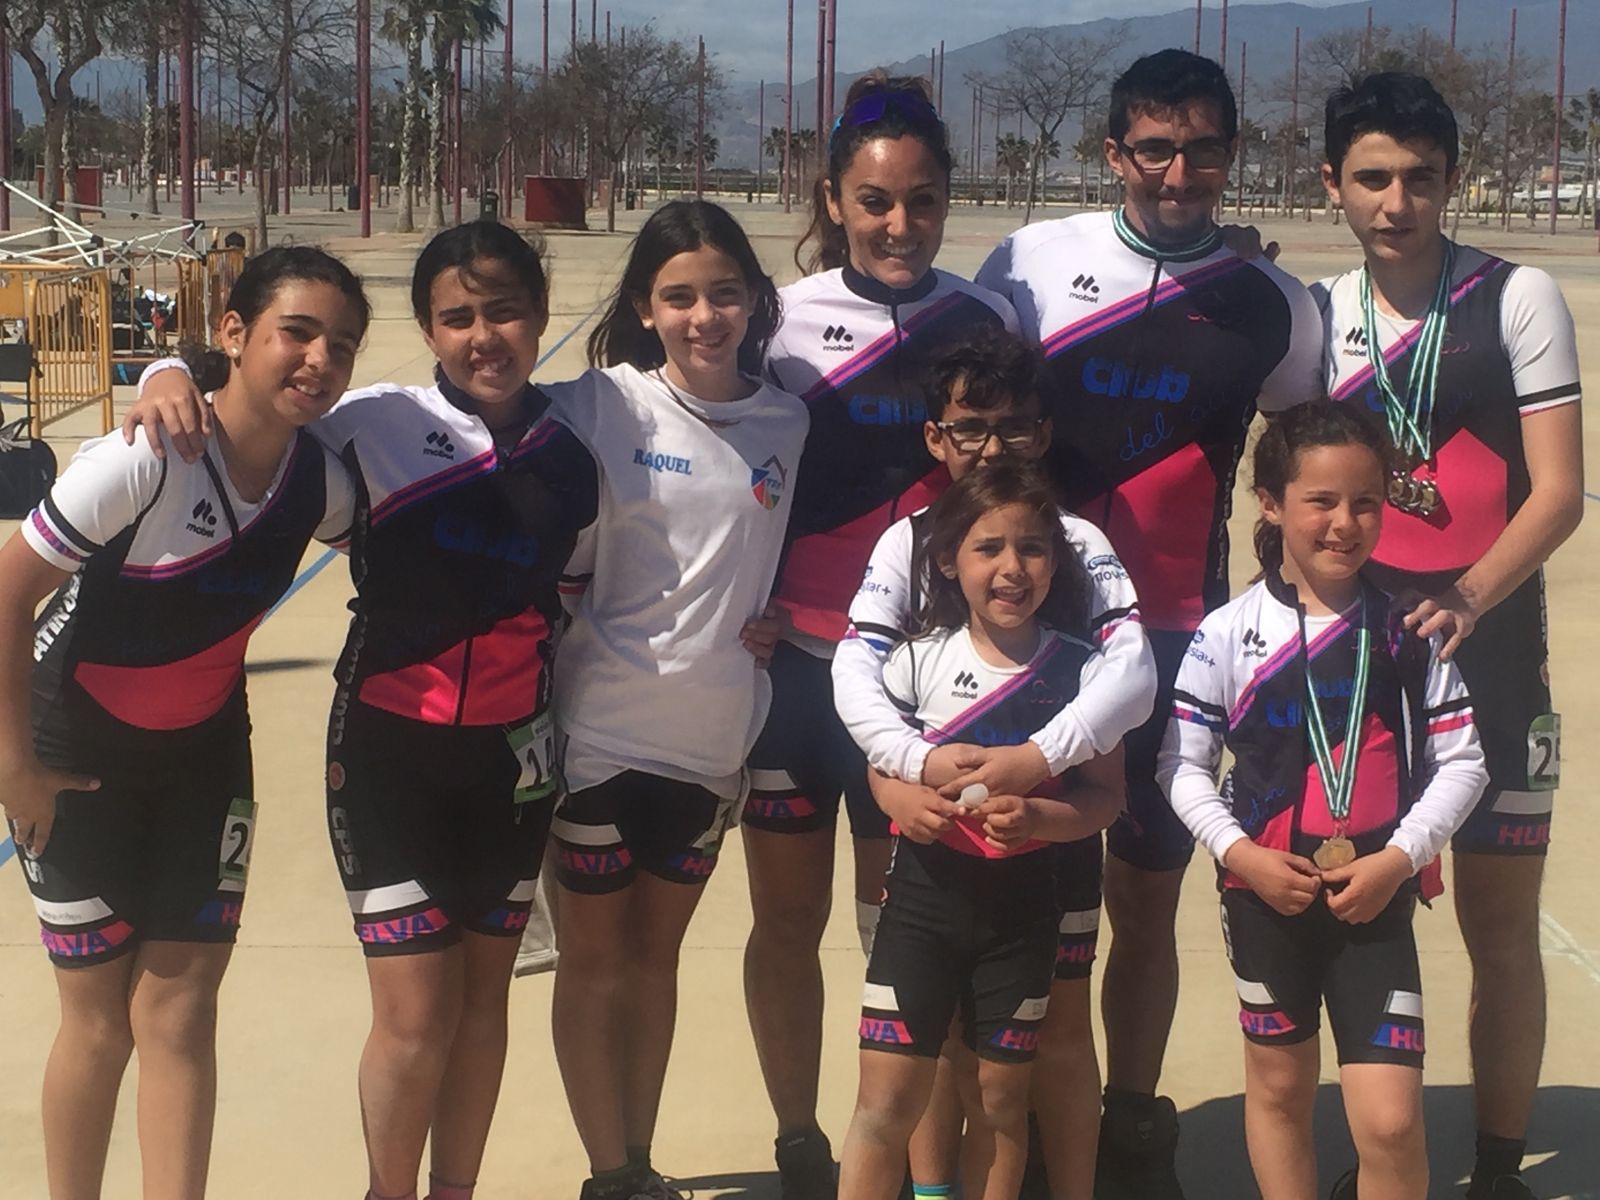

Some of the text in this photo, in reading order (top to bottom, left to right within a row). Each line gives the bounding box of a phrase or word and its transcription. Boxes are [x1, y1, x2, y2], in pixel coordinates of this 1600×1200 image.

[1068, 291, 1100, 303] mobel
[822, 344, 855, 352] mobel
[1119, 411, 1175, 461] del
[632, 448, 693, 476] RAQUEL
[185, 522, 216, 539] mobel
[951, 690, 978, 700] mobel
[1534, 736, 1561, 783] 2
